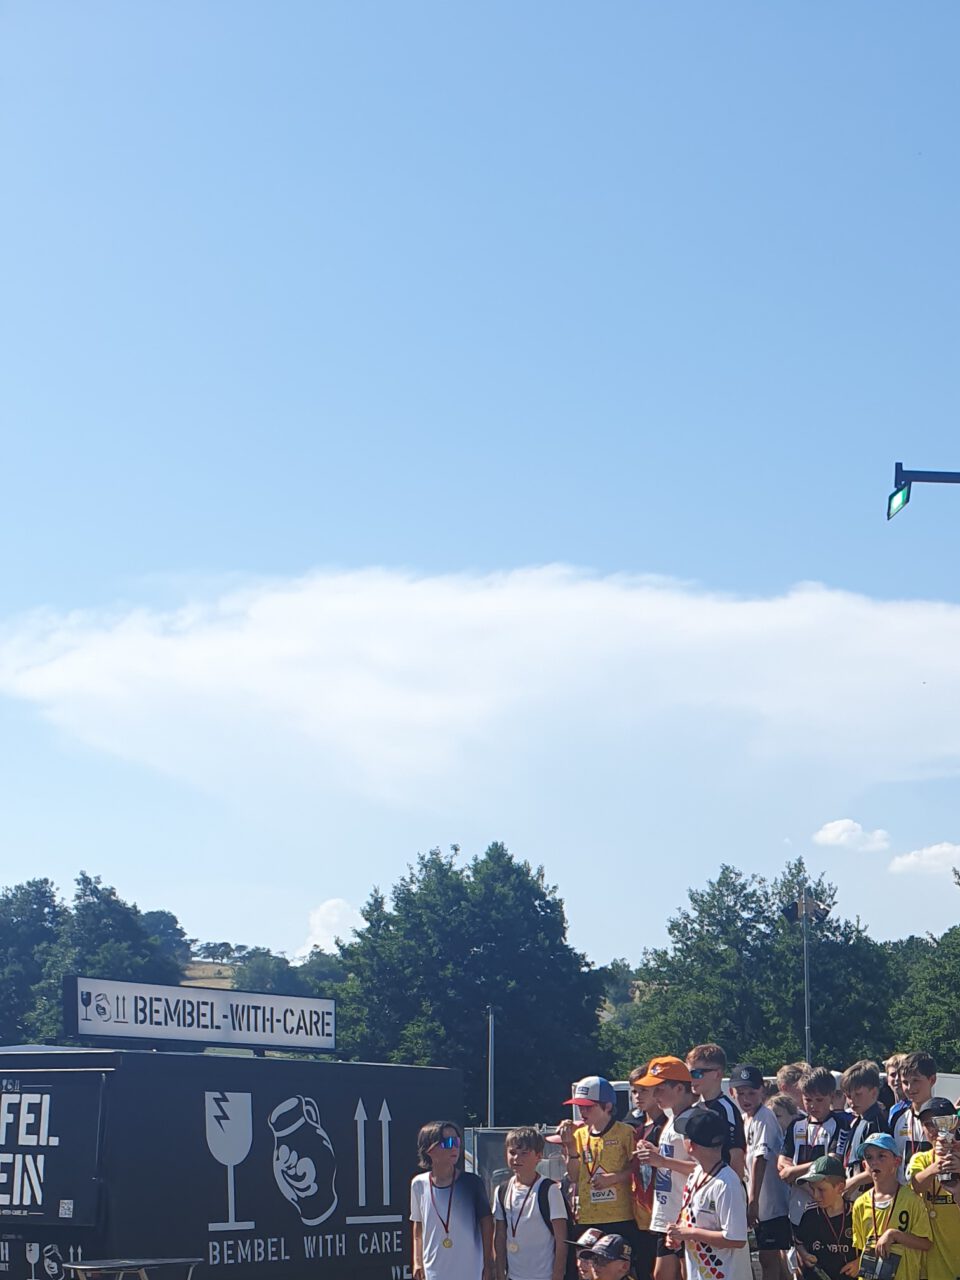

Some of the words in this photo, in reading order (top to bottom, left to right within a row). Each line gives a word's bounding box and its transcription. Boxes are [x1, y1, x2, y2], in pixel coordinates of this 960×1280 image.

[134, 995, 333, 1037] BEMBEL-WITH-CARE
[898, 1210, 909, 1232] 9
[208, 1237, 290, 1265] BEMBEL
[303, 1233, 346, 1258] WITH
[358, 1231, 402, 1254] CARE
